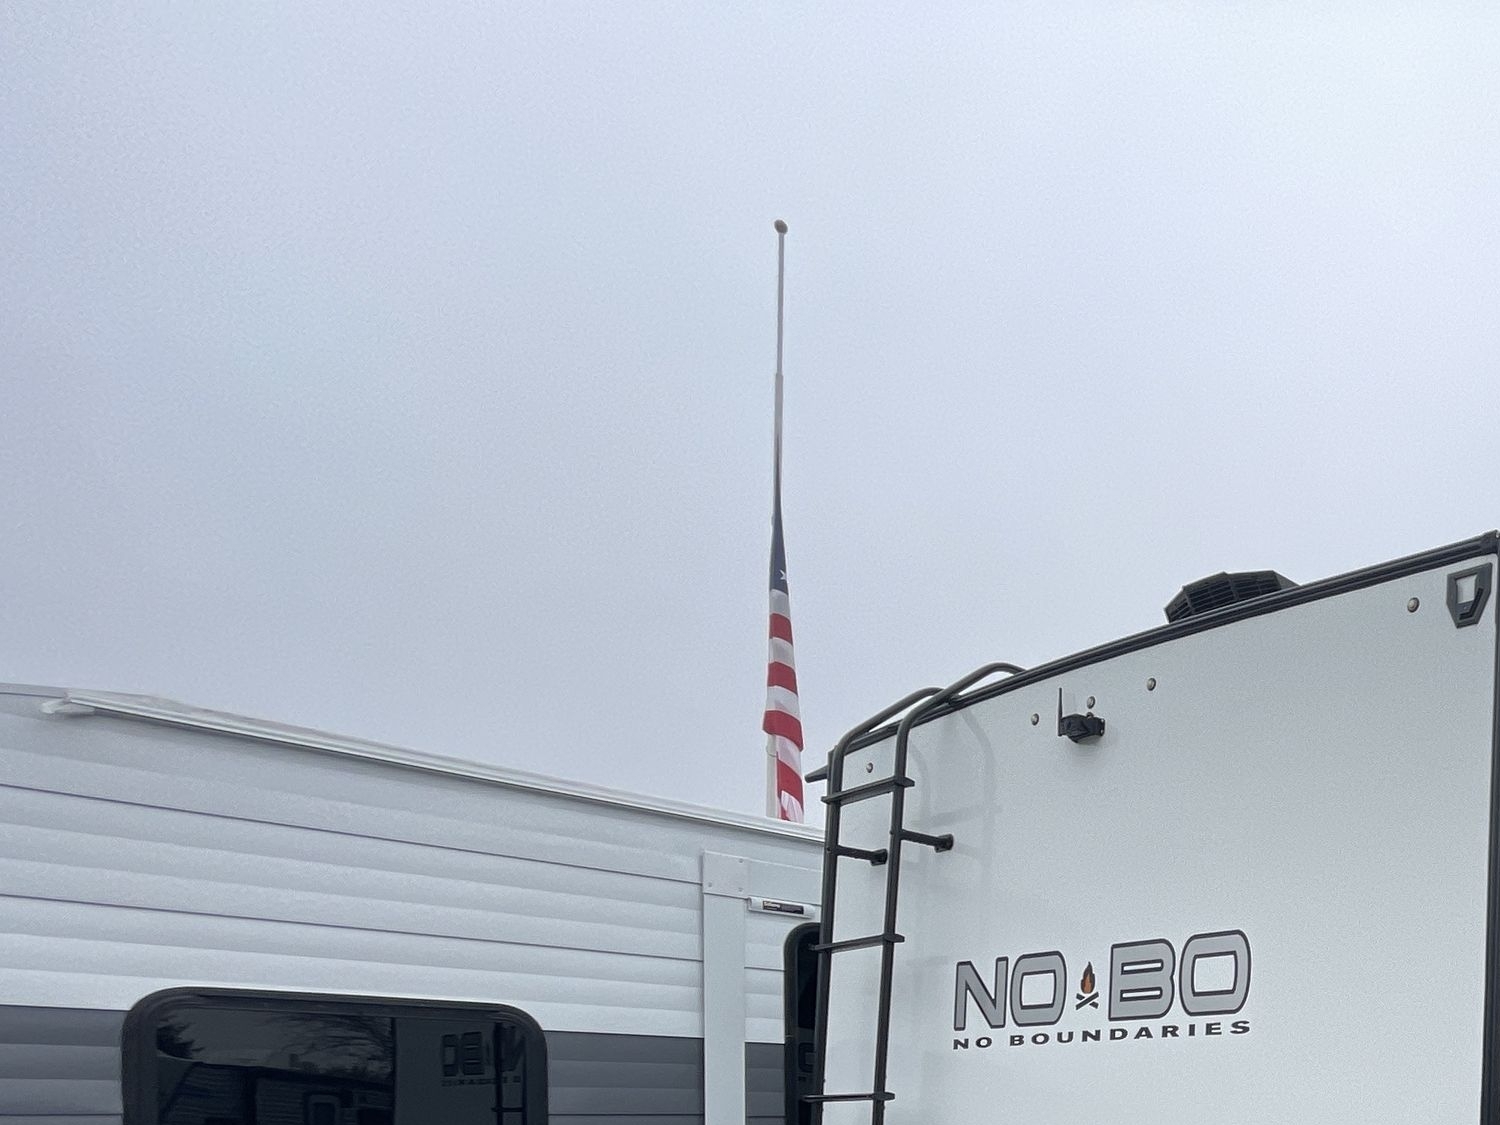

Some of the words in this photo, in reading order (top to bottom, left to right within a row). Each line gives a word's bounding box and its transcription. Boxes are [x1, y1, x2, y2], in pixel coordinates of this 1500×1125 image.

[953, 950, 1068, 1032] NO
[1108, 929, 1252, 1022] BO
[953, 1036, 993, 1050] NO
[1009, 1020, 1251, 1047] BOUNDARIES
